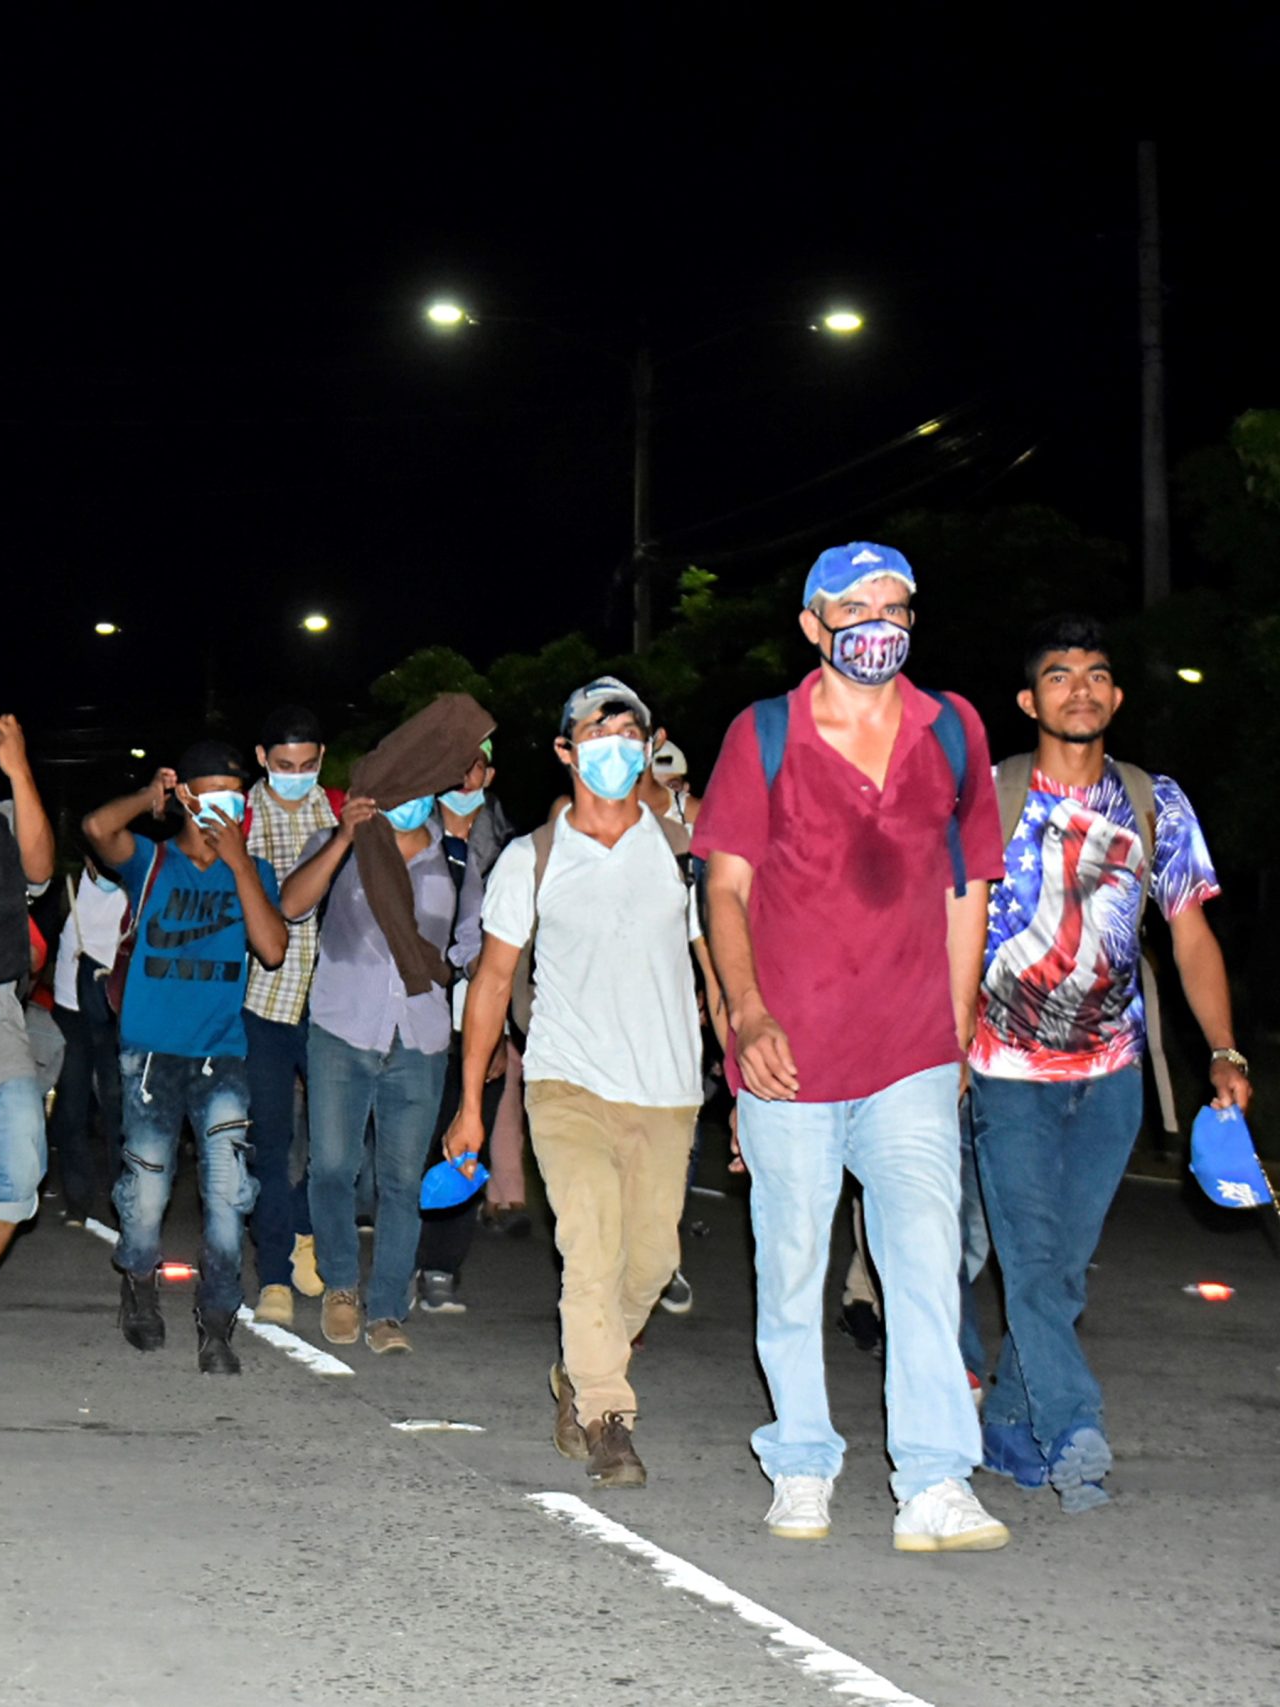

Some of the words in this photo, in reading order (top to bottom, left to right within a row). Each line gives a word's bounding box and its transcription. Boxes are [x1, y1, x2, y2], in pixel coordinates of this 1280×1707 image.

[839, 631, 907, 670] CRISTO
[162, 887, 239, 921] NIKE
[167, 959, 226, 980] AIR
